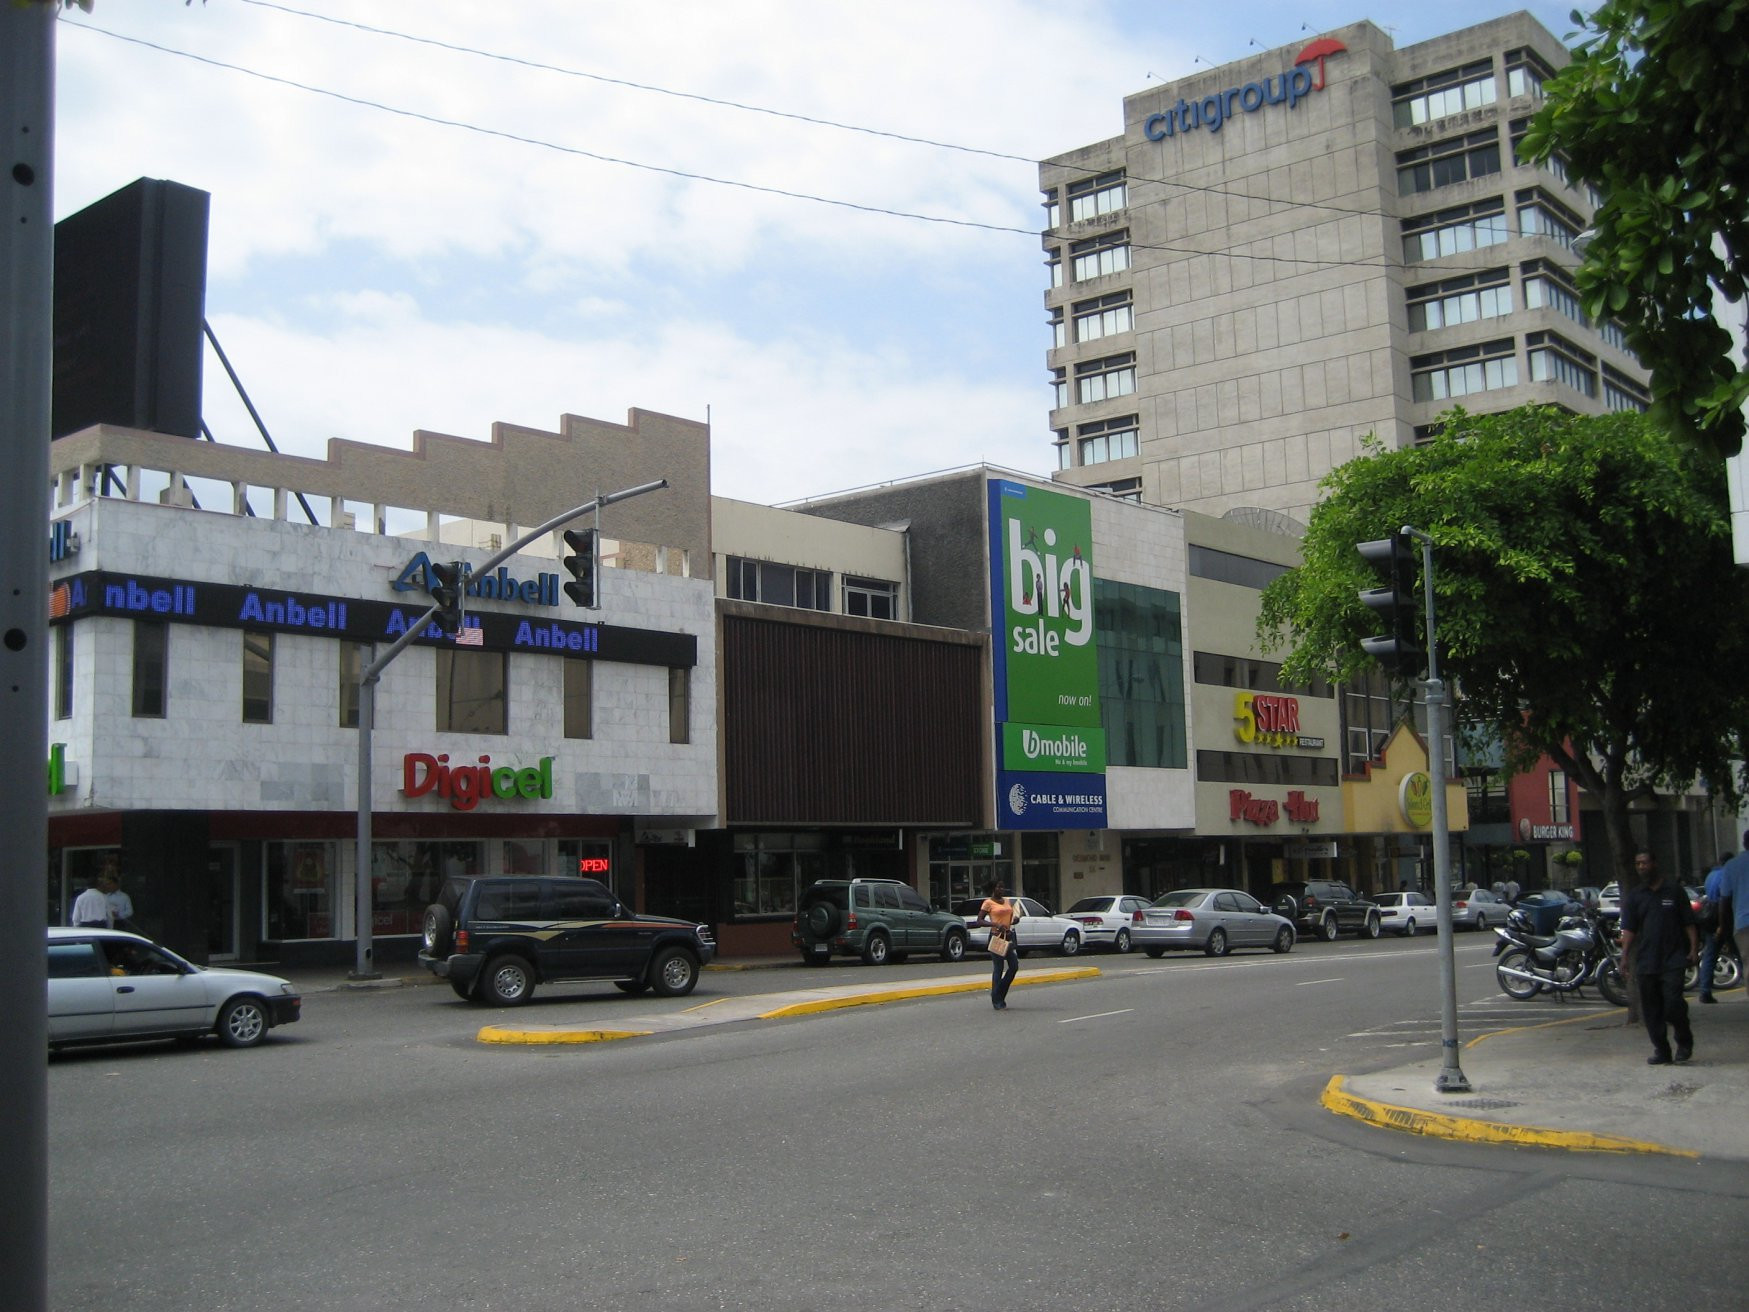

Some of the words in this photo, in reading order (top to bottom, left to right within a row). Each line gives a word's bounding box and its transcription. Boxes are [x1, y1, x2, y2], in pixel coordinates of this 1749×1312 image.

[1144, 65, 1313, 142] citigroup
[1009, 518, 1093, 647] big
[238, 592, 348, 630] Anbell
[385, 607, 482, 641] Anbll
[514, 620, 598, 652] Anbell
[1013, 618, 1060, 657] sale
[1058, 694, 1077, 706] now
[1079, 694, 1092, 707] on!
[1233, 691, 1256, 744] 5
[1254, 694, 1300, 733] STAR
[404, 752, 555, 810] Digicel
[1030, 794, 1057, 804] CABLE
[1057, 795, 1065, 804] &
[1065, 794, 1103, 805] WIRELESS
[1229, 789, 1280, 827] Pizza
[1283, 790, 1320, 823] Hut
[1533, 825, 1557, 839] BURGER
[1558, 825, 1573, 838] KING
